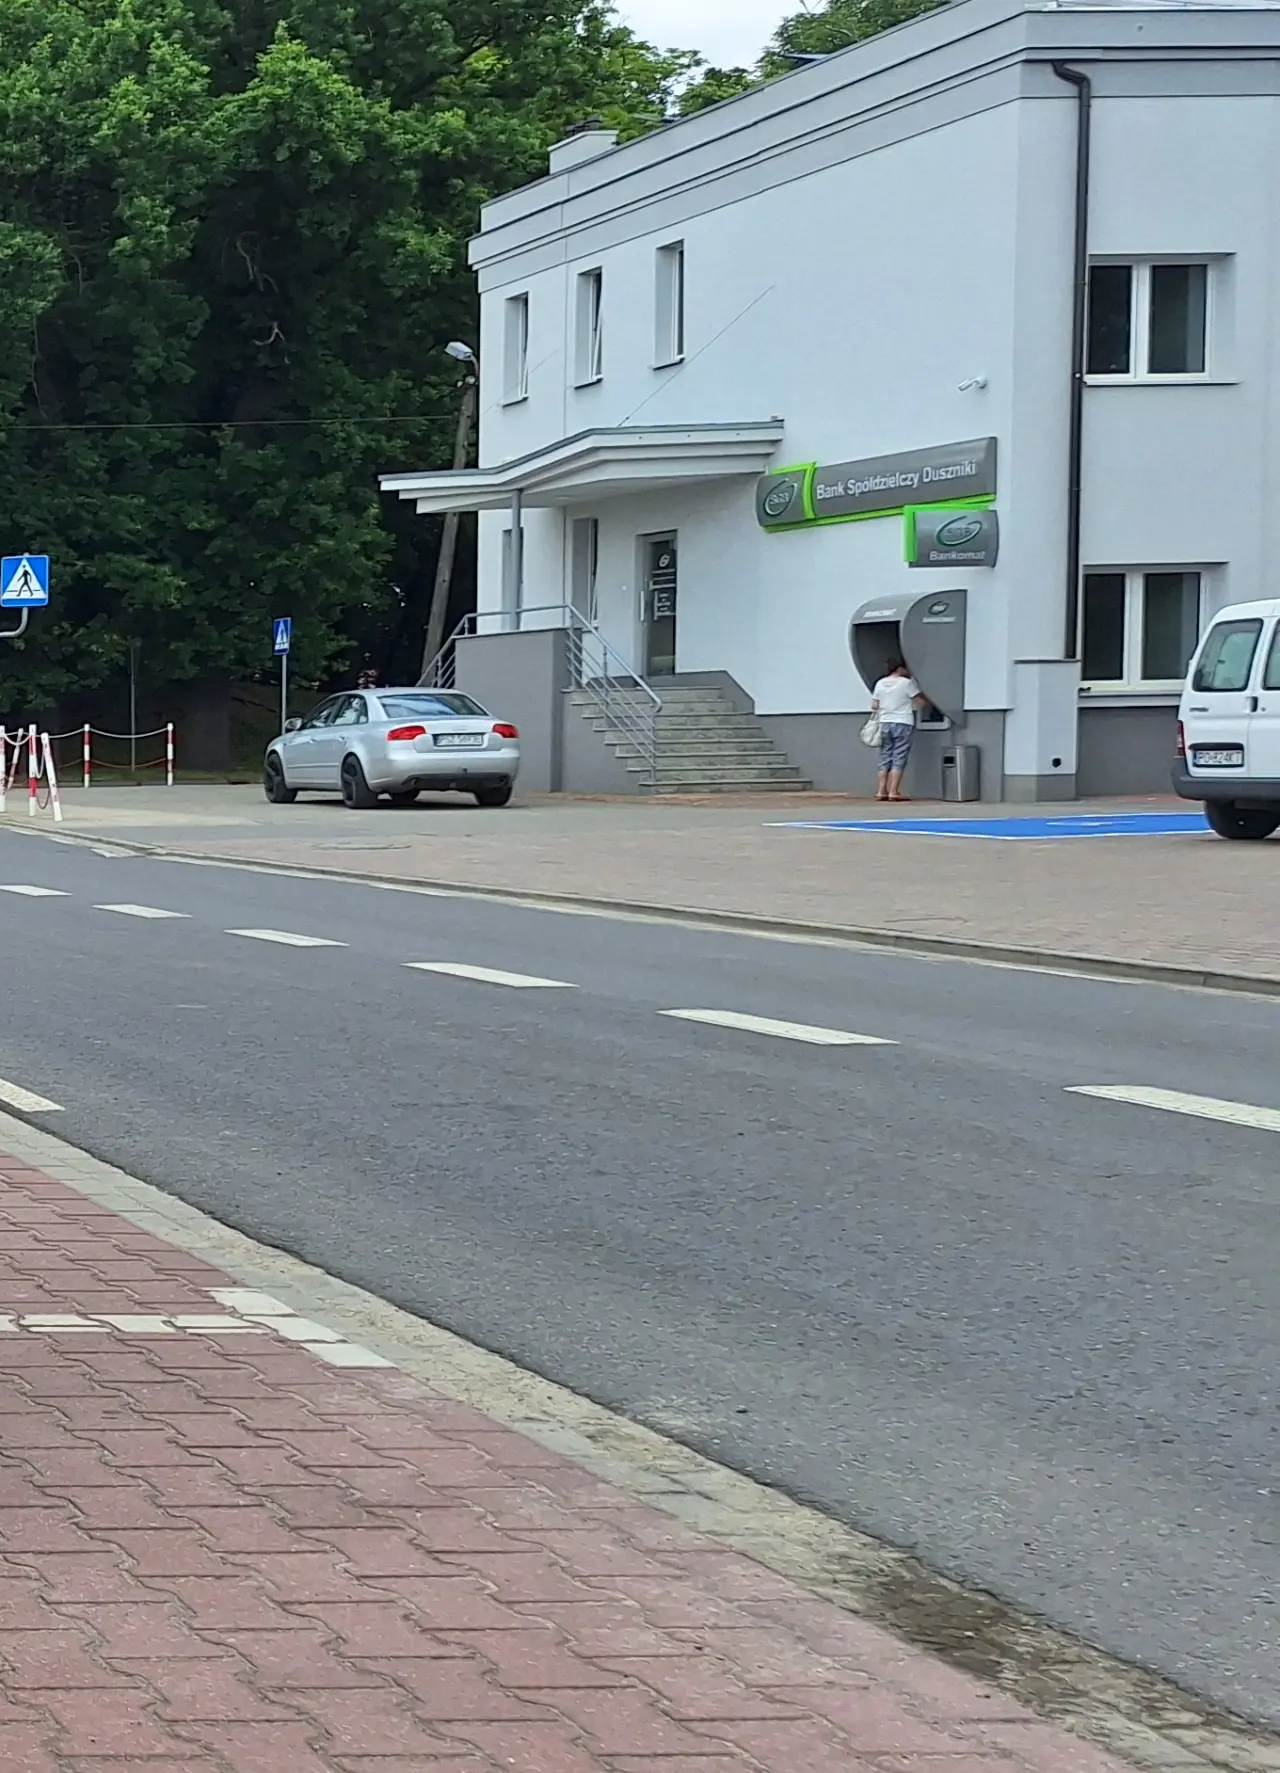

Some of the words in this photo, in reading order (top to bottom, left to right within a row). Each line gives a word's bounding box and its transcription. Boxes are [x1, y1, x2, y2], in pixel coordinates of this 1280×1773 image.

[816, 482, 845, 500] Bank
[847, 472, 920, 498] Spółdzielczy
[923, 459, 977, 483] Duszniki
[929, 550, 986, 561] Bankomat
